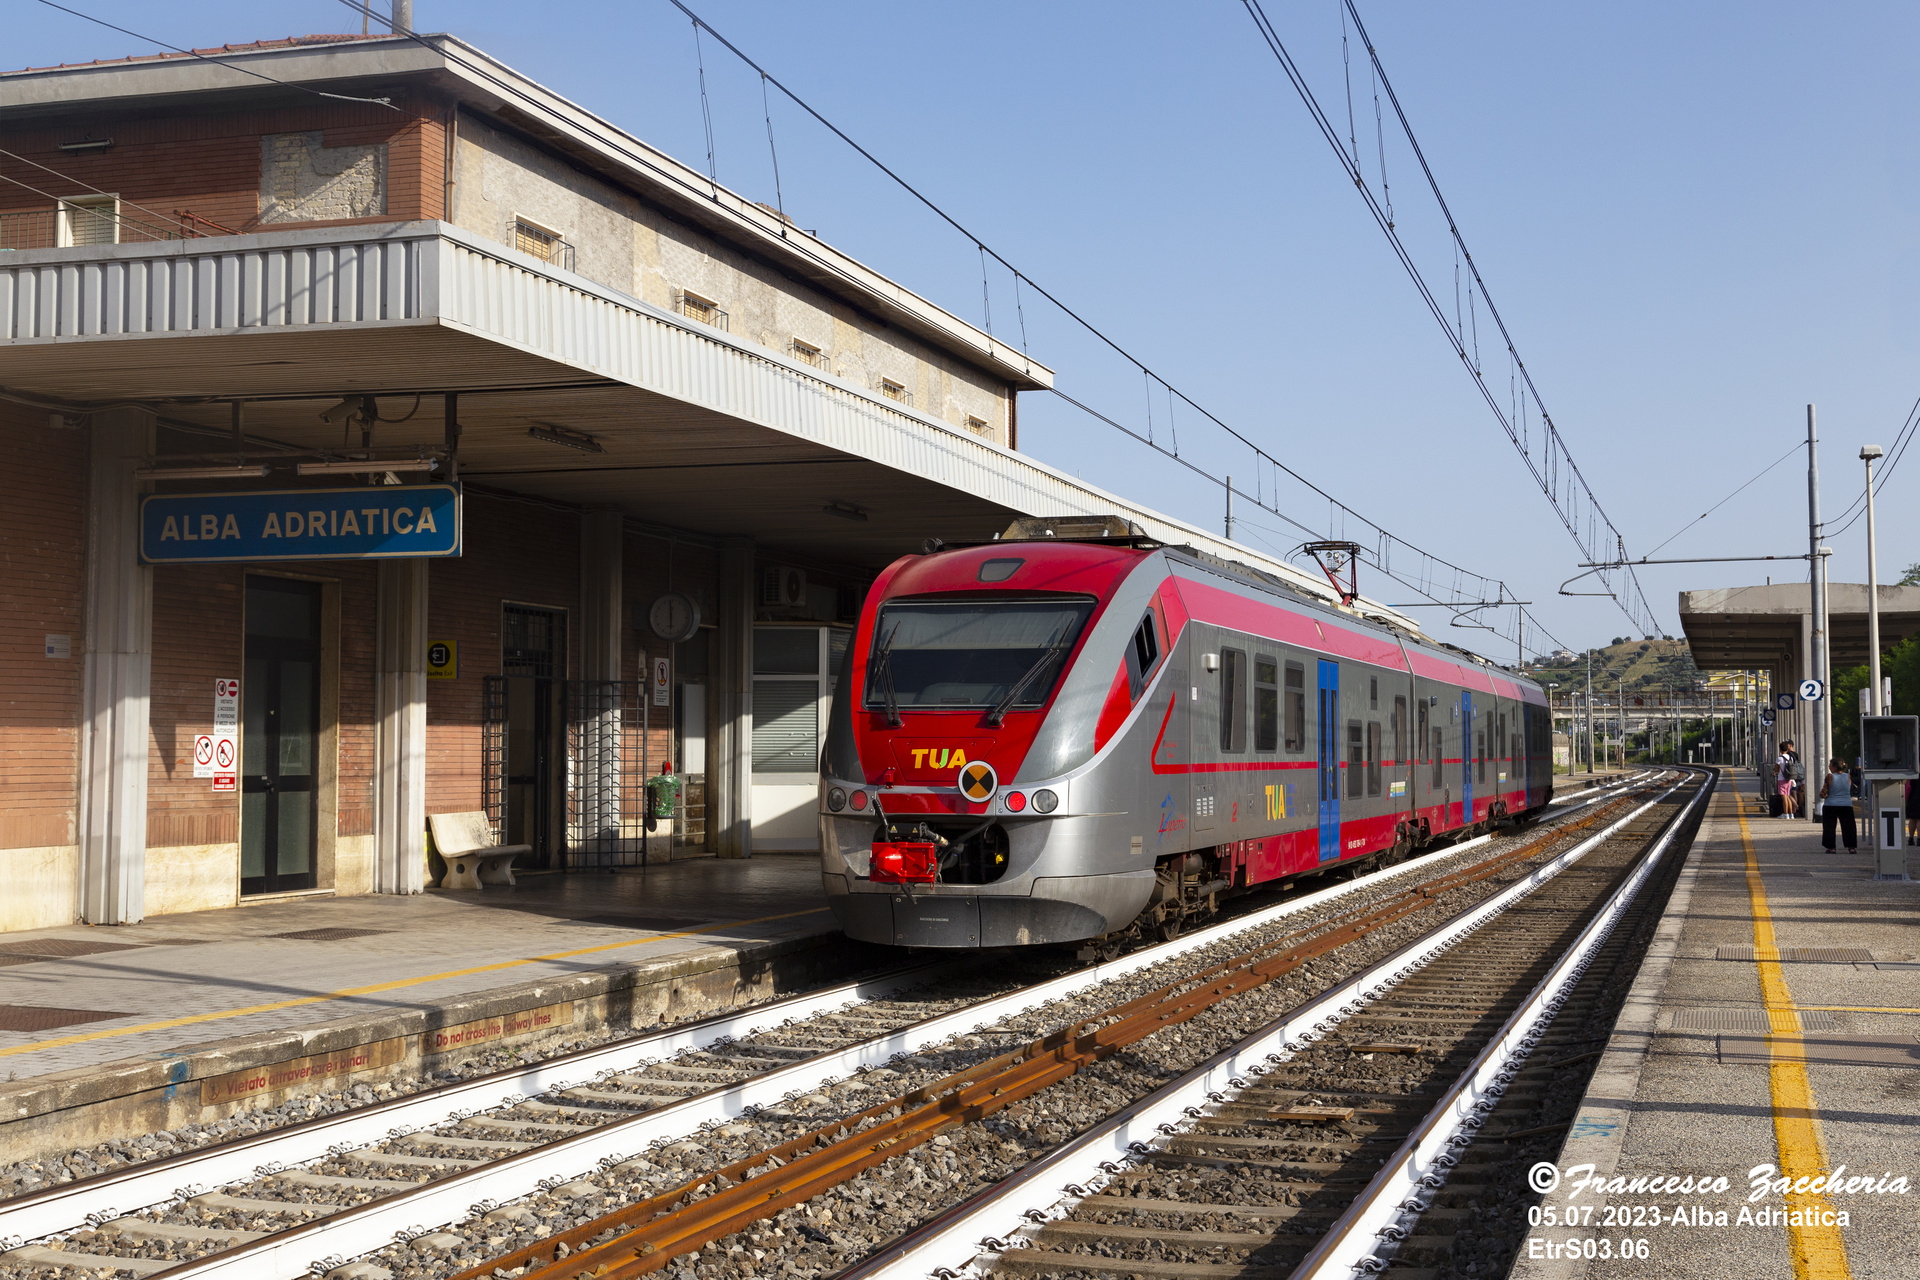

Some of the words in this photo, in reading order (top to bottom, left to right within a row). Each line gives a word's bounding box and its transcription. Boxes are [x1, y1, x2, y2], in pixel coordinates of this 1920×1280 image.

[160, 514, 241, 541] ALBA
[261, 506, 437, 538] ADRIATICA
[1805, 683, 1816, 697] 2
[911, 749, 967, 770] TUA
[1231, 801, 1238, 823] 2
[1265, 784, 1286, 821] TUA
[1881, 811, 1900, 847] T
[436, 1033, 449, 1047] Do
[450, 1030, 464, 1045] not
[466, 1028, 486, 1041] cross
[487, 1022, 501, 1036] the
[503, 1016, 533, 1033] railway
[534, 1013, 551, 1027] lines
[226, 1077, 266, 1096] Vietato
[268, 1063, 332, 1086] attraversare
[339, 1054, 370, 1070] binari
